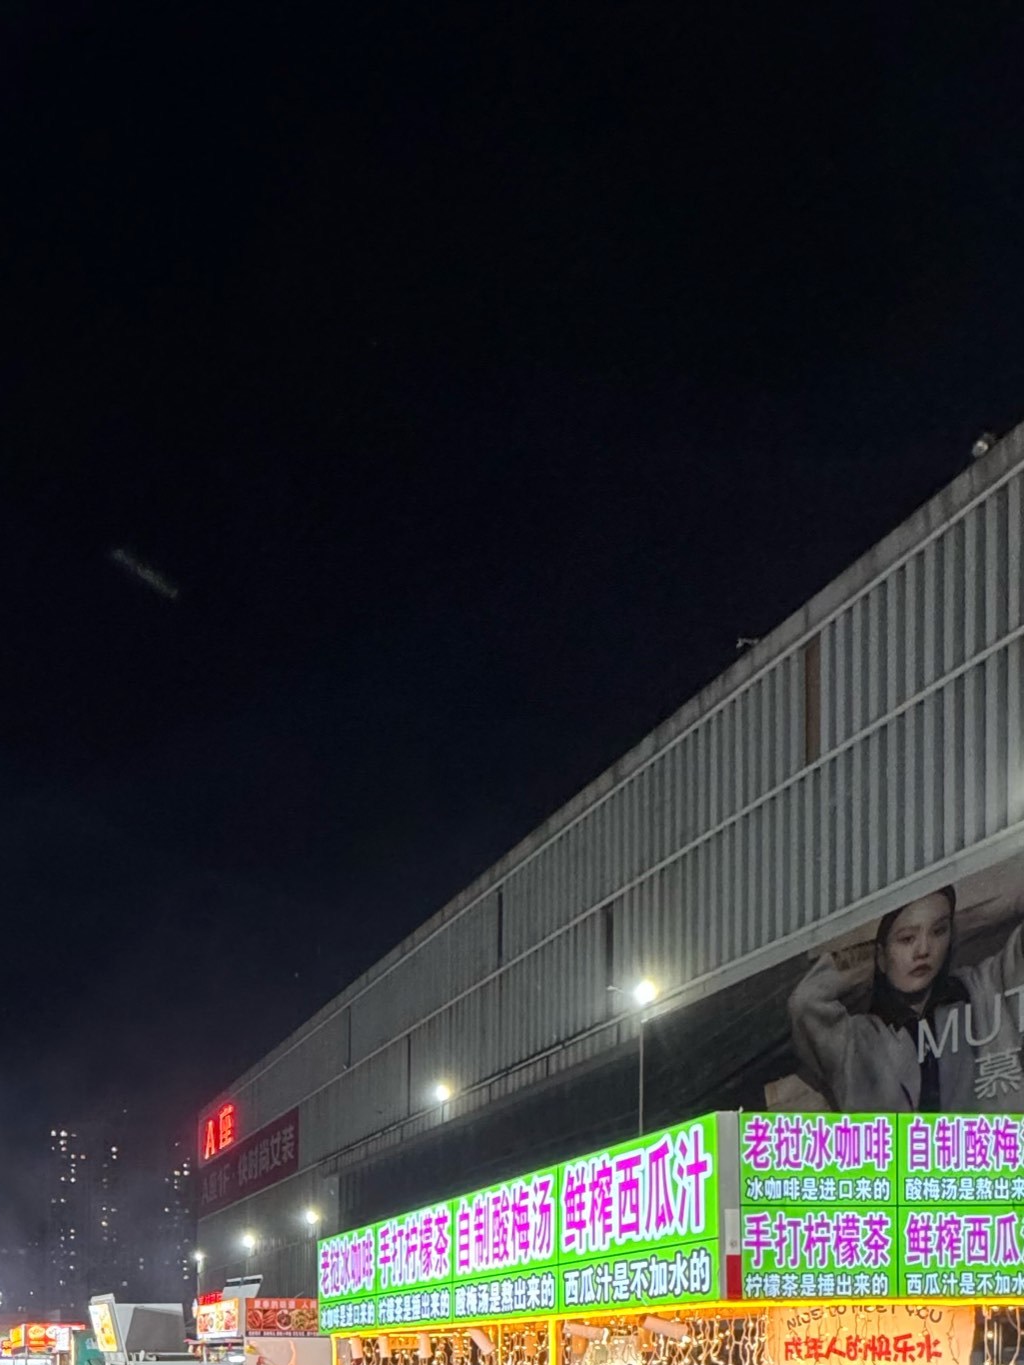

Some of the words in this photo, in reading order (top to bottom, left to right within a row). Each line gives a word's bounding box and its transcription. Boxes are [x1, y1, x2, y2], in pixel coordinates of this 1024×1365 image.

[204, 1104, 234, 1160] A座
[744, 1116, 892, 1171] 老挝冰咖啡
[907, 1116, 1024, 1171] 自制酸梅
[378, 1203, 451, 1289] 手打柠檬茶
[456, 1174, 554, 1275] 自制酸梅汤
[561, 1124, 712, 1255] 鲜榨西瓜汁
[746, 1177, 890, 1201] 冰咖啡是进口来的
[743, 1211, 890, 1269] 手打柠檬茶
[905, 1211, 1024, 1269] 鲜榨西瓜
[563, 1247, 710, 1307] 西瓜汁是不加水的
